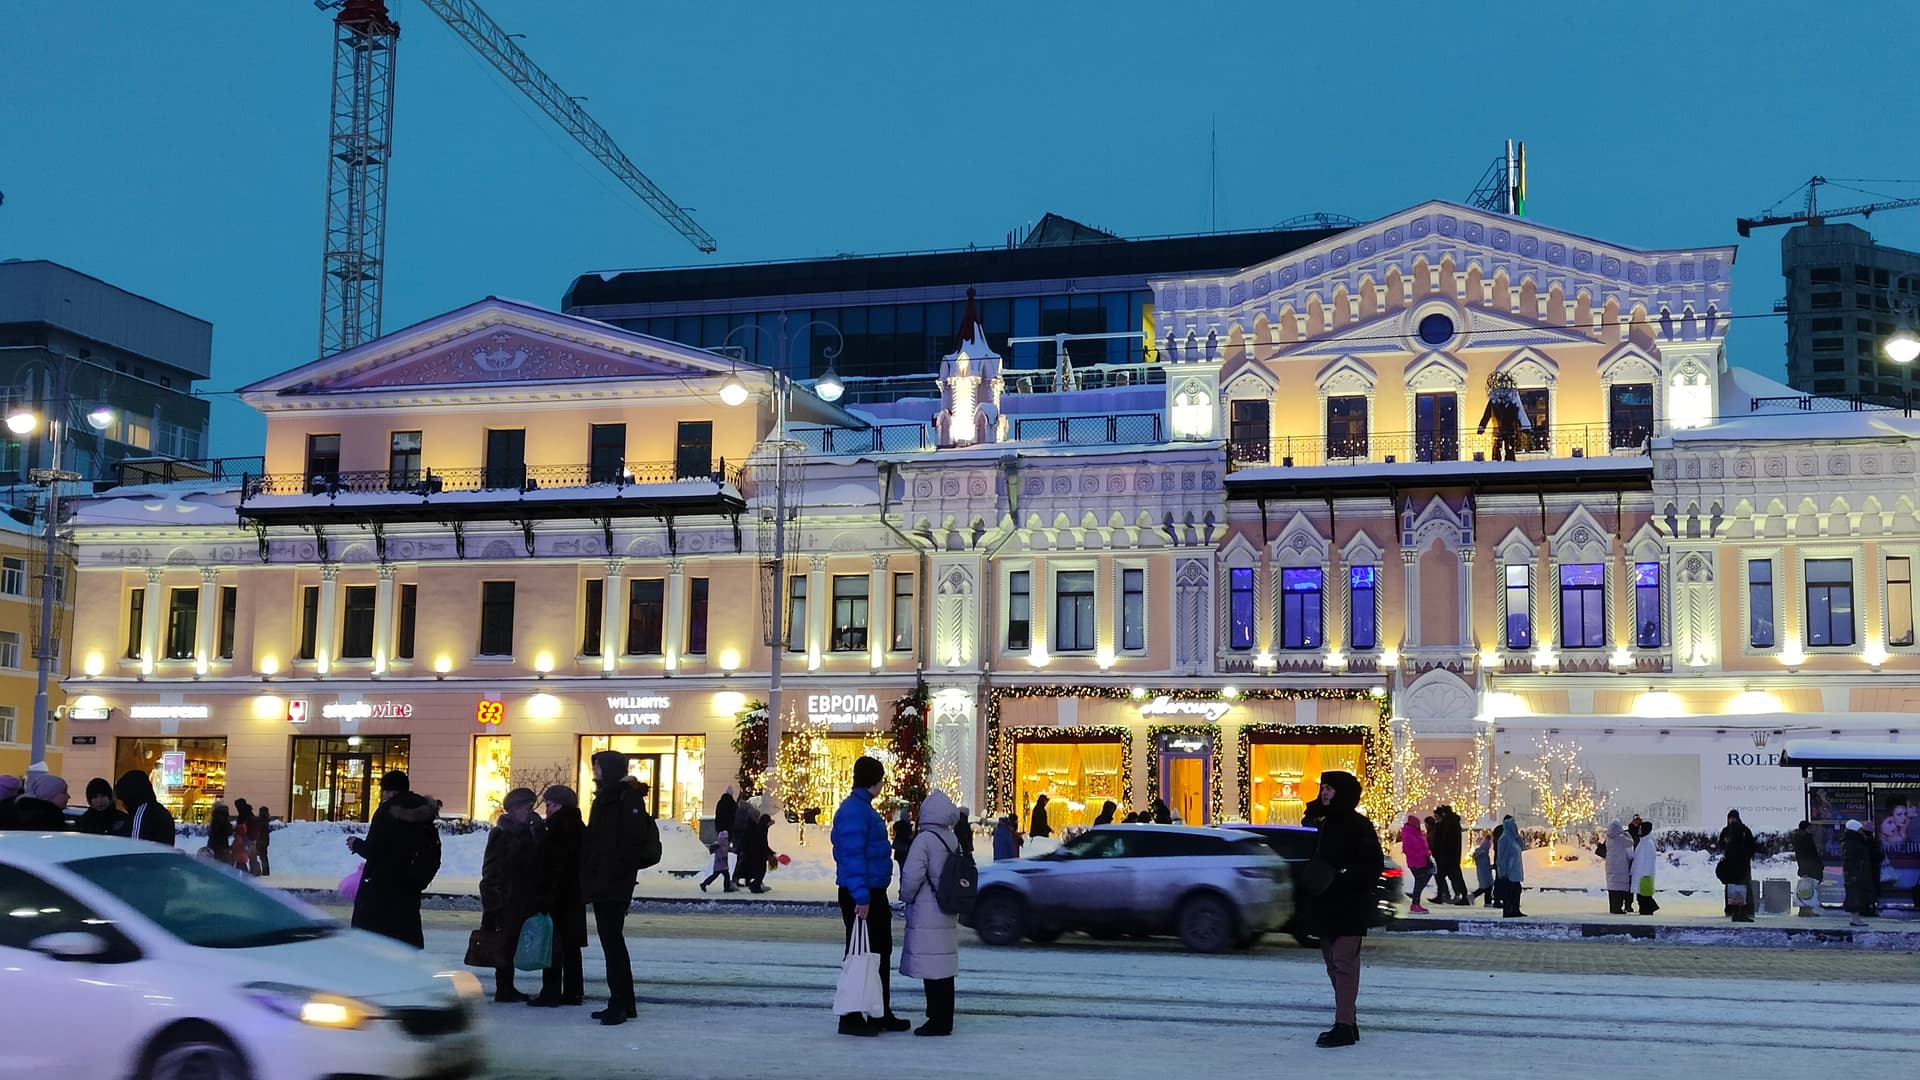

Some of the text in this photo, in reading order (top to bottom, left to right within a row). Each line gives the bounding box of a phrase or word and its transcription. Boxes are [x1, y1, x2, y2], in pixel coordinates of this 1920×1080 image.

[808, 694, 878, 713] ЕВРОПА
[1139, 695, 1231, 721] Mercury
[1727, 753, 1781, 766] ROLE
[1748, 784, 1777, 792] БУТИК
